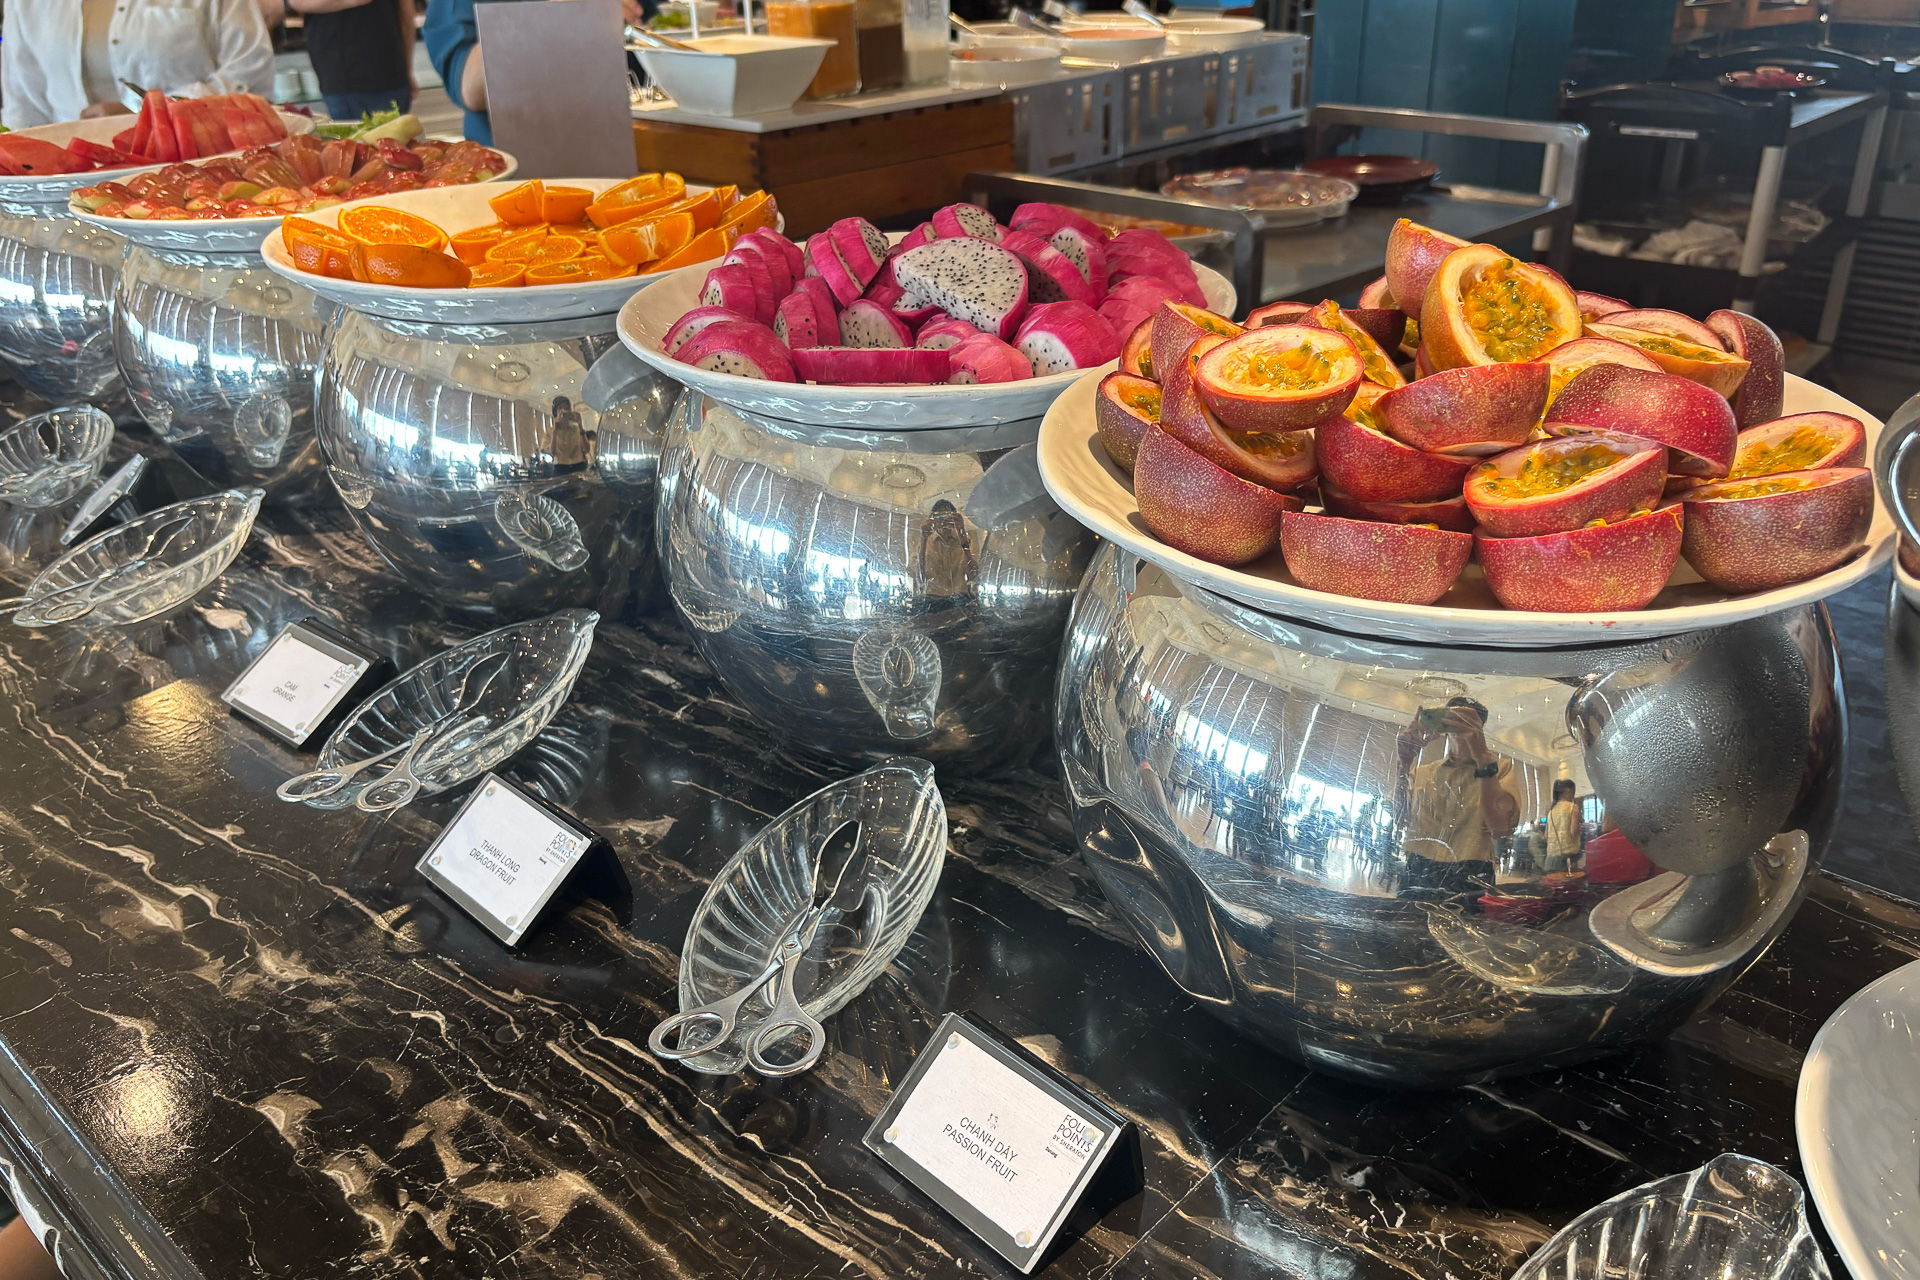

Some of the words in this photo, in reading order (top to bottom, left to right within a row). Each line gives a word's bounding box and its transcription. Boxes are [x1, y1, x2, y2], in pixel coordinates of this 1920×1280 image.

[273, 686, 296, 702] ORANGE
[285, 681, 298, 691] CAM
[469, 847, 498, 872] DRAGON
[494, 867, 517, 886] FRUIT
[481, 839, 503, 860] THANH
[500, 854, 521, 873] LONG
[942, 1123, 988, 1161] PASSION
[985, 1154, 1019, 1182] FRUIT
[960, 1117, 996, 1147] CHANH
[994, 1141, 1019, 1163] DÂY
[1052, 1134, 1061, 1142] BY
[1060, 1139, 1086, 1160] SHERATON
[1056, 1123, 1093, 1153] POINTS
